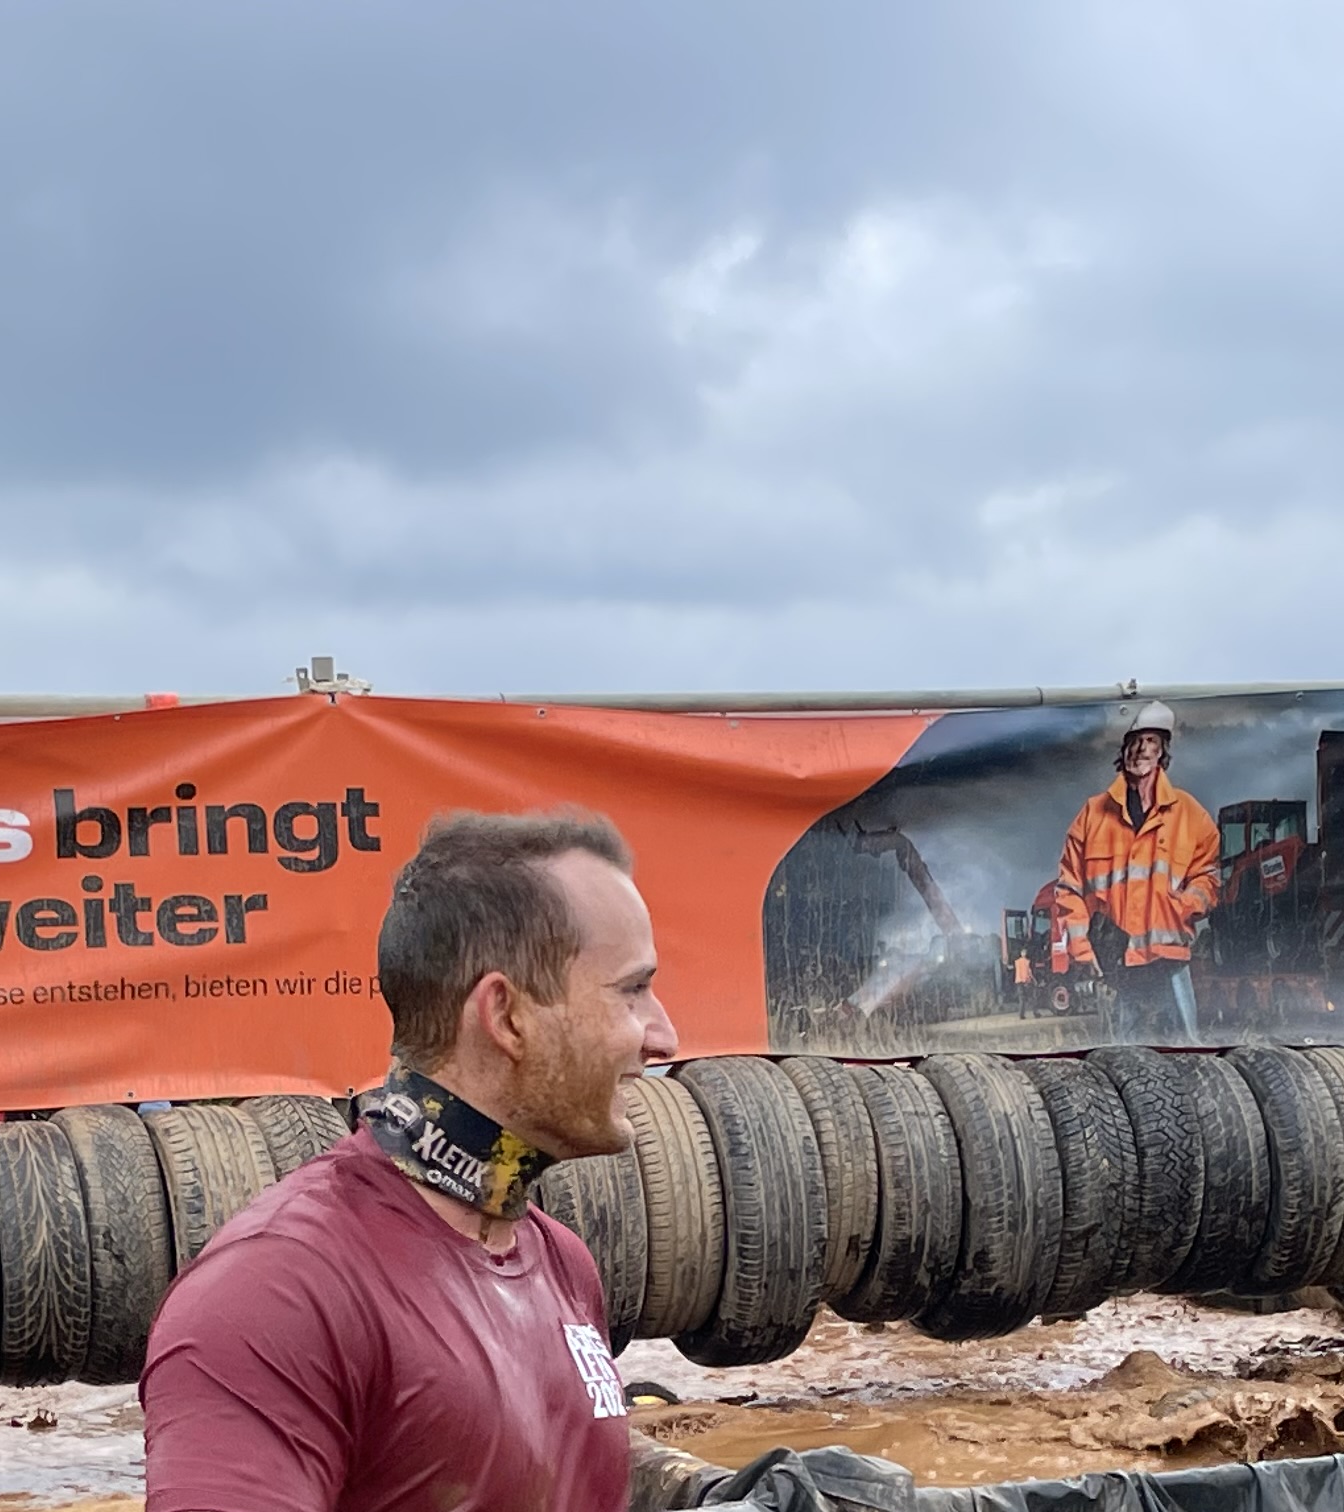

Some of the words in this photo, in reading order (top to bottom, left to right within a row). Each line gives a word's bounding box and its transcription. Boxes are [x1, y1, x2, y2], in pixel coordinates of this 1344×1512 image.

[53, 783, 381, 874] bringt
[32, 976, 177, 1004] entstehen,
[184, 974, 268, 998] bieten
[274, 971, 318, 996] wir
[323, 970, 362, 996] die
[412, 1121, 491, 1188] XLETIX
